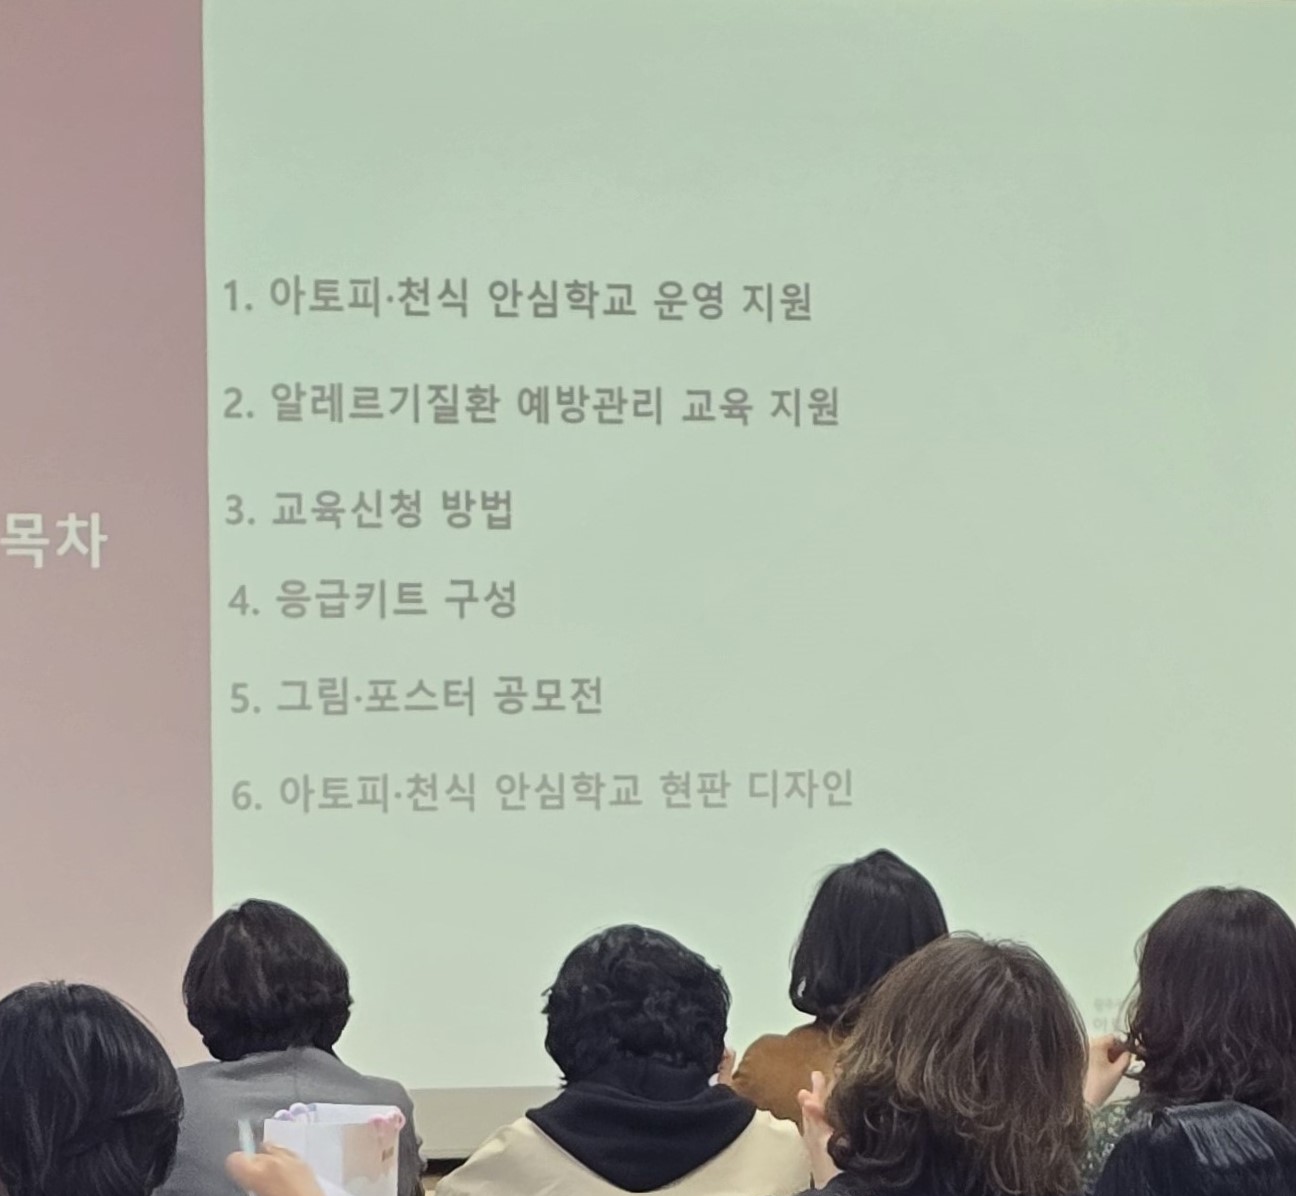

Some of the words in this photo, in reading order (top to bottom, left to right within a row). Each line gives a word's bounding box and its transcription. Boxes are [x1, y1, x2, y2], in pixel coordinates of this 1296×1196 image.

[225, 281, 254, 312] 1.
[489, 279, 638, 321] 안심학교
[655, 282, 724, 322] 운영
[744, 283, 812, 324] 지원
[225, 388, 255, 420] 2.
[272, 383, 502, 425] 알레르기질환
[518, 386, 663, 427] 예방관리
[683, 388, 754, 427] 교육
[771, 387, 839, 428] 지원
[226, 495, 256, 526] 3.
[273, 490, 422, 531] 교육신청
[443, 491, 512, 531] 방법
[1, 514, 108, 569] 목차
[229, 586, 261, 617] 4.
[277, 580, 428, 621] 응급키트
[446, 580, 517, 621] 구성
[232, 683, 262, 715] 5.
[495, 677, 603, 716] 공모전
[233, 782, 263, 811] 6.
[497, 772, 644, 812] 안심학교
[661, 771, 732, 809] 현판
[750, 770, 853, 809] 디자인
